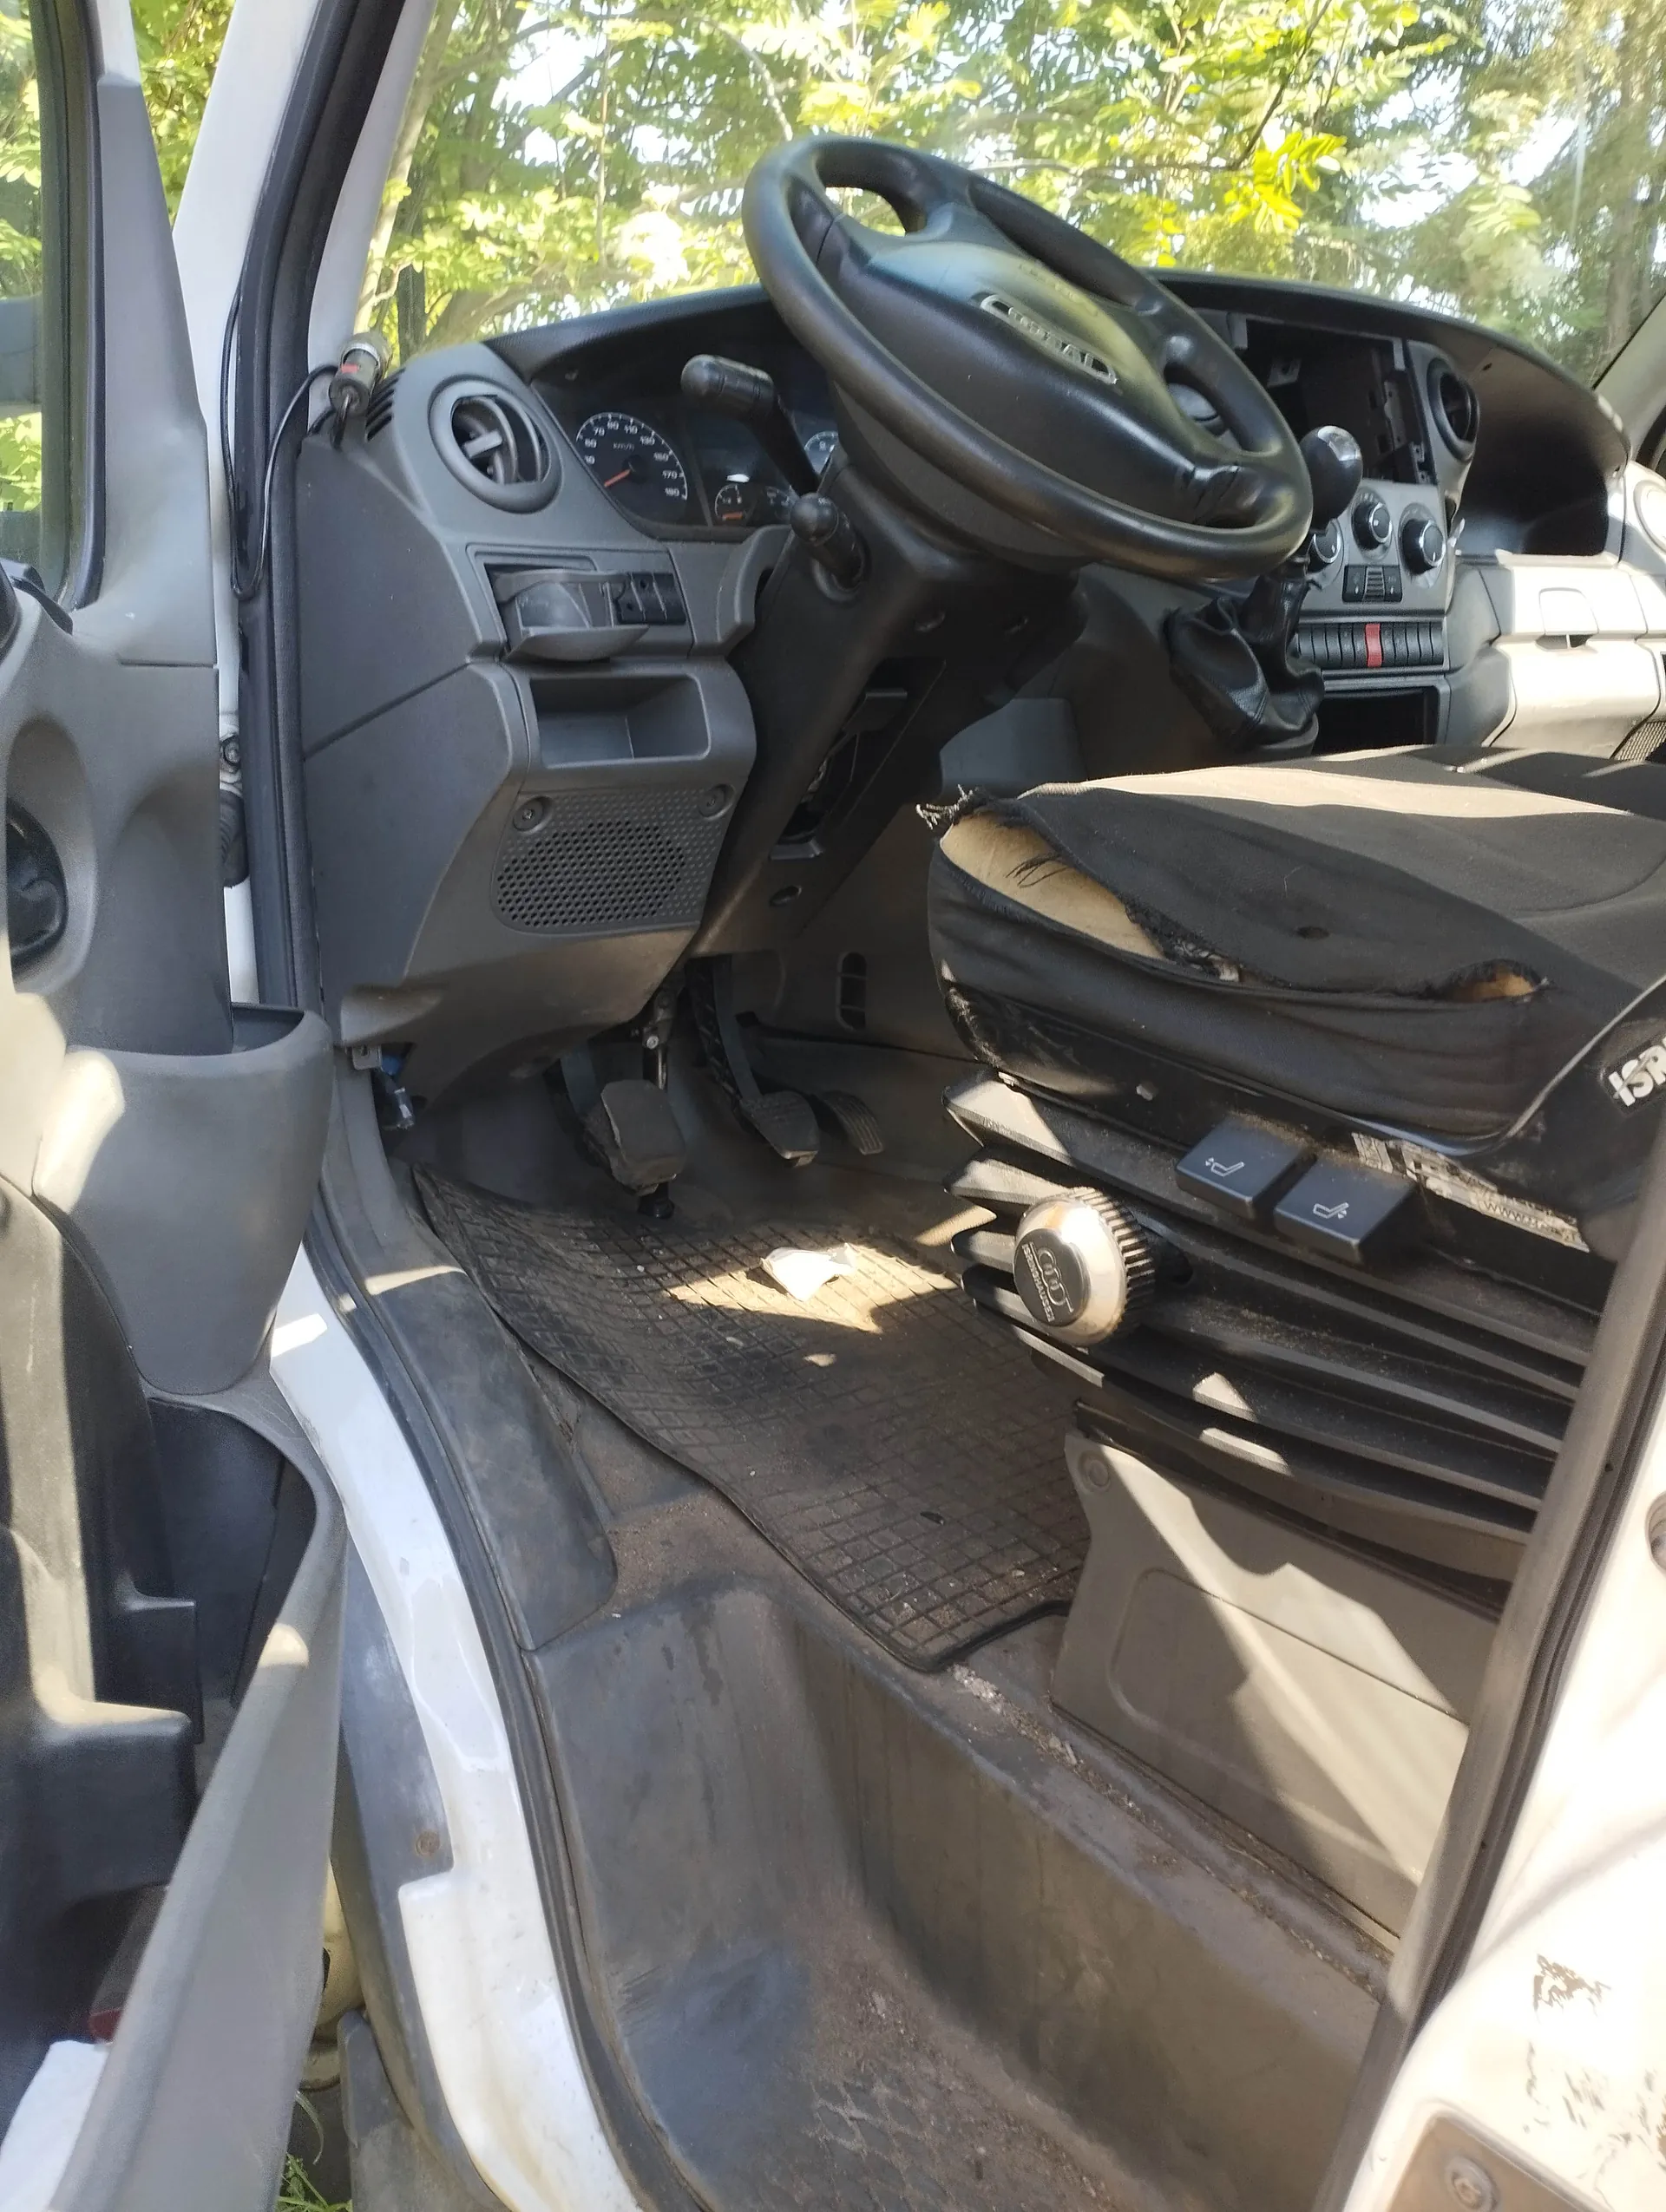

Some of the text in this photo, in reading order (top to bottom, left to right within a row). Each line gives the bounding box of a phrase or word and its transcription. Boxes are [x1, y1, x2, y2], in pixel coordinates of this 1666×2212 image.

[594, 427, 605, 436] 70
[663, 470, 678, 479] 170
[1609, 1036, 1666, 1106] ISR
[1022, 1243, 1054, 1322] ISRINGHAUSEN
